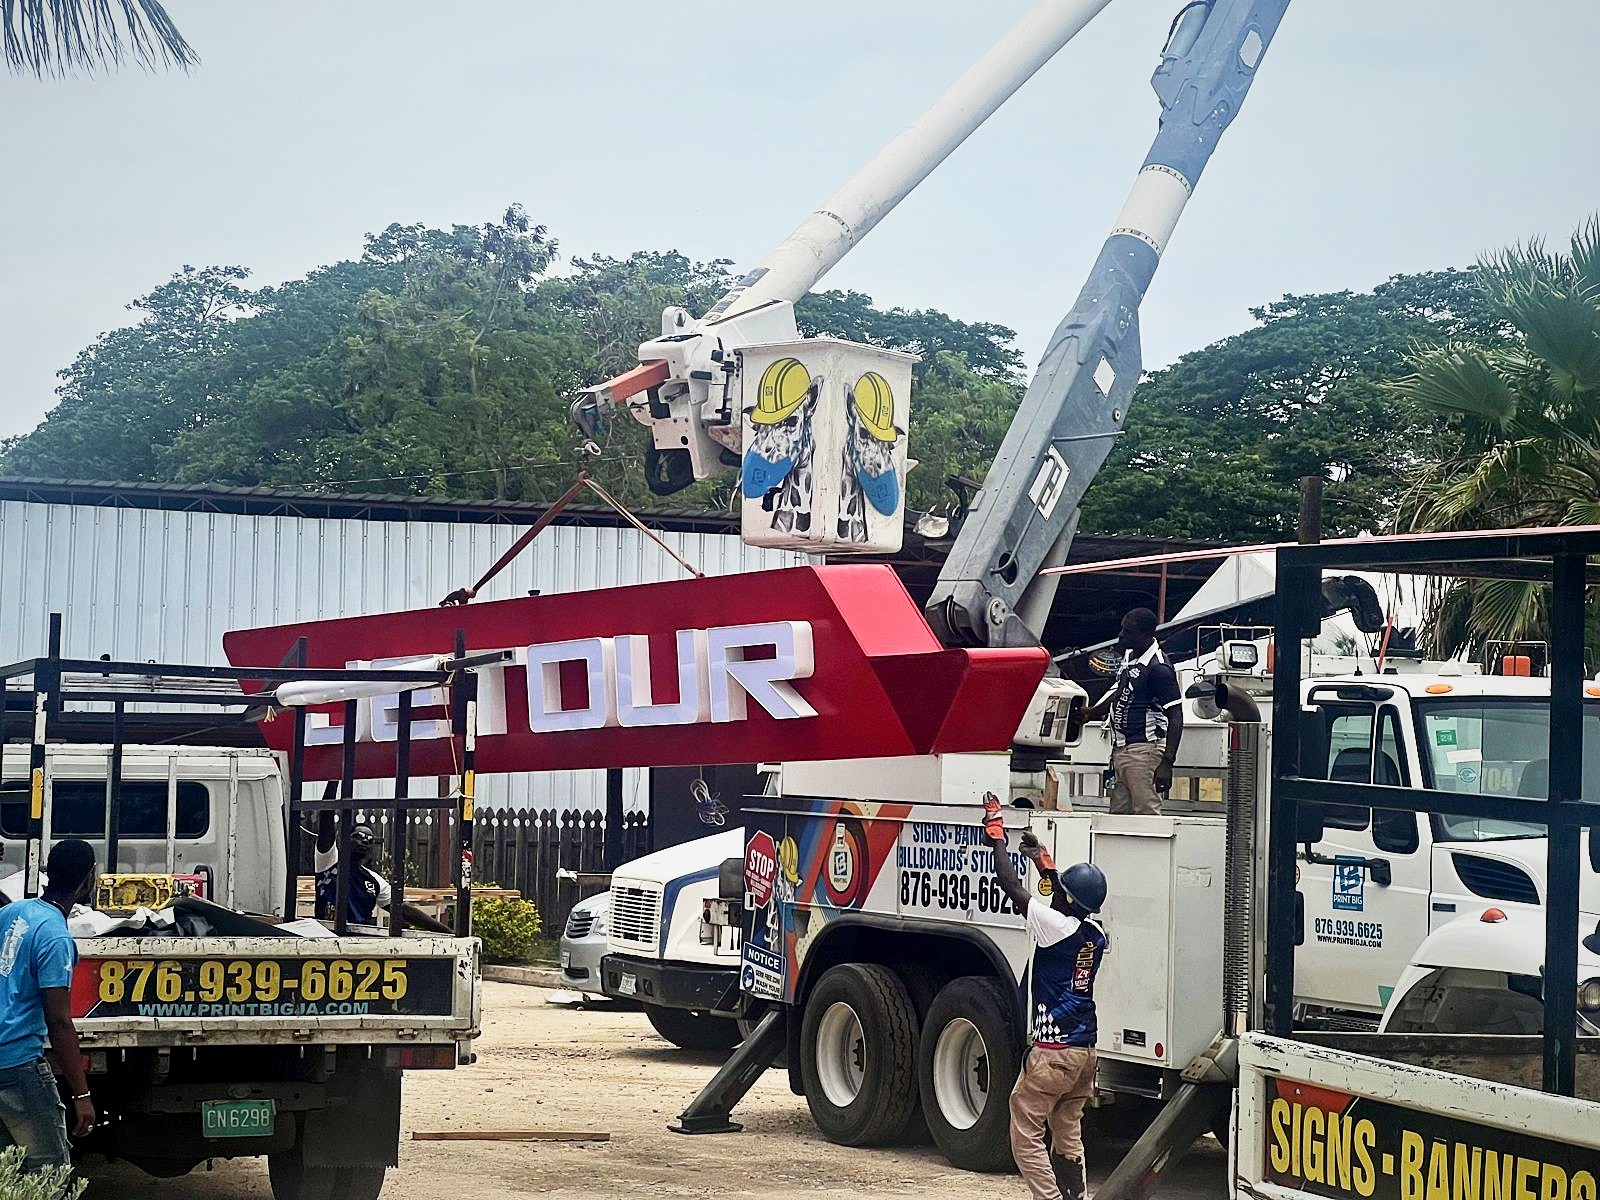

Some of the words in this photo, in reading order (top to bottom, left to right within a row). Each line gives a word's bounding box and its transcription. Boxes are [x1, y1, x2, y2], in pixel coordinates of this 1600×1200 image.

[1114, 700, 1125, 730] PRINT
[749, 849, 775, 879] STOP
[971, 850, 1027, 876] STICRS
[1333, 894, 1351, 904] PRINT
[1352, 896, 1363, 905] BIG
[1315, 917, 1383, 940] 876.939.6625
[1317, 935, 1382, 948] WWW.PRINTBIGJA.COM
[748, 948, 780, 969] NOTICE
[99, 960, 408, 1002] 876.939-6625
[138, 1003, 369, 1016] WWW.PRINTBIGJA.COM
